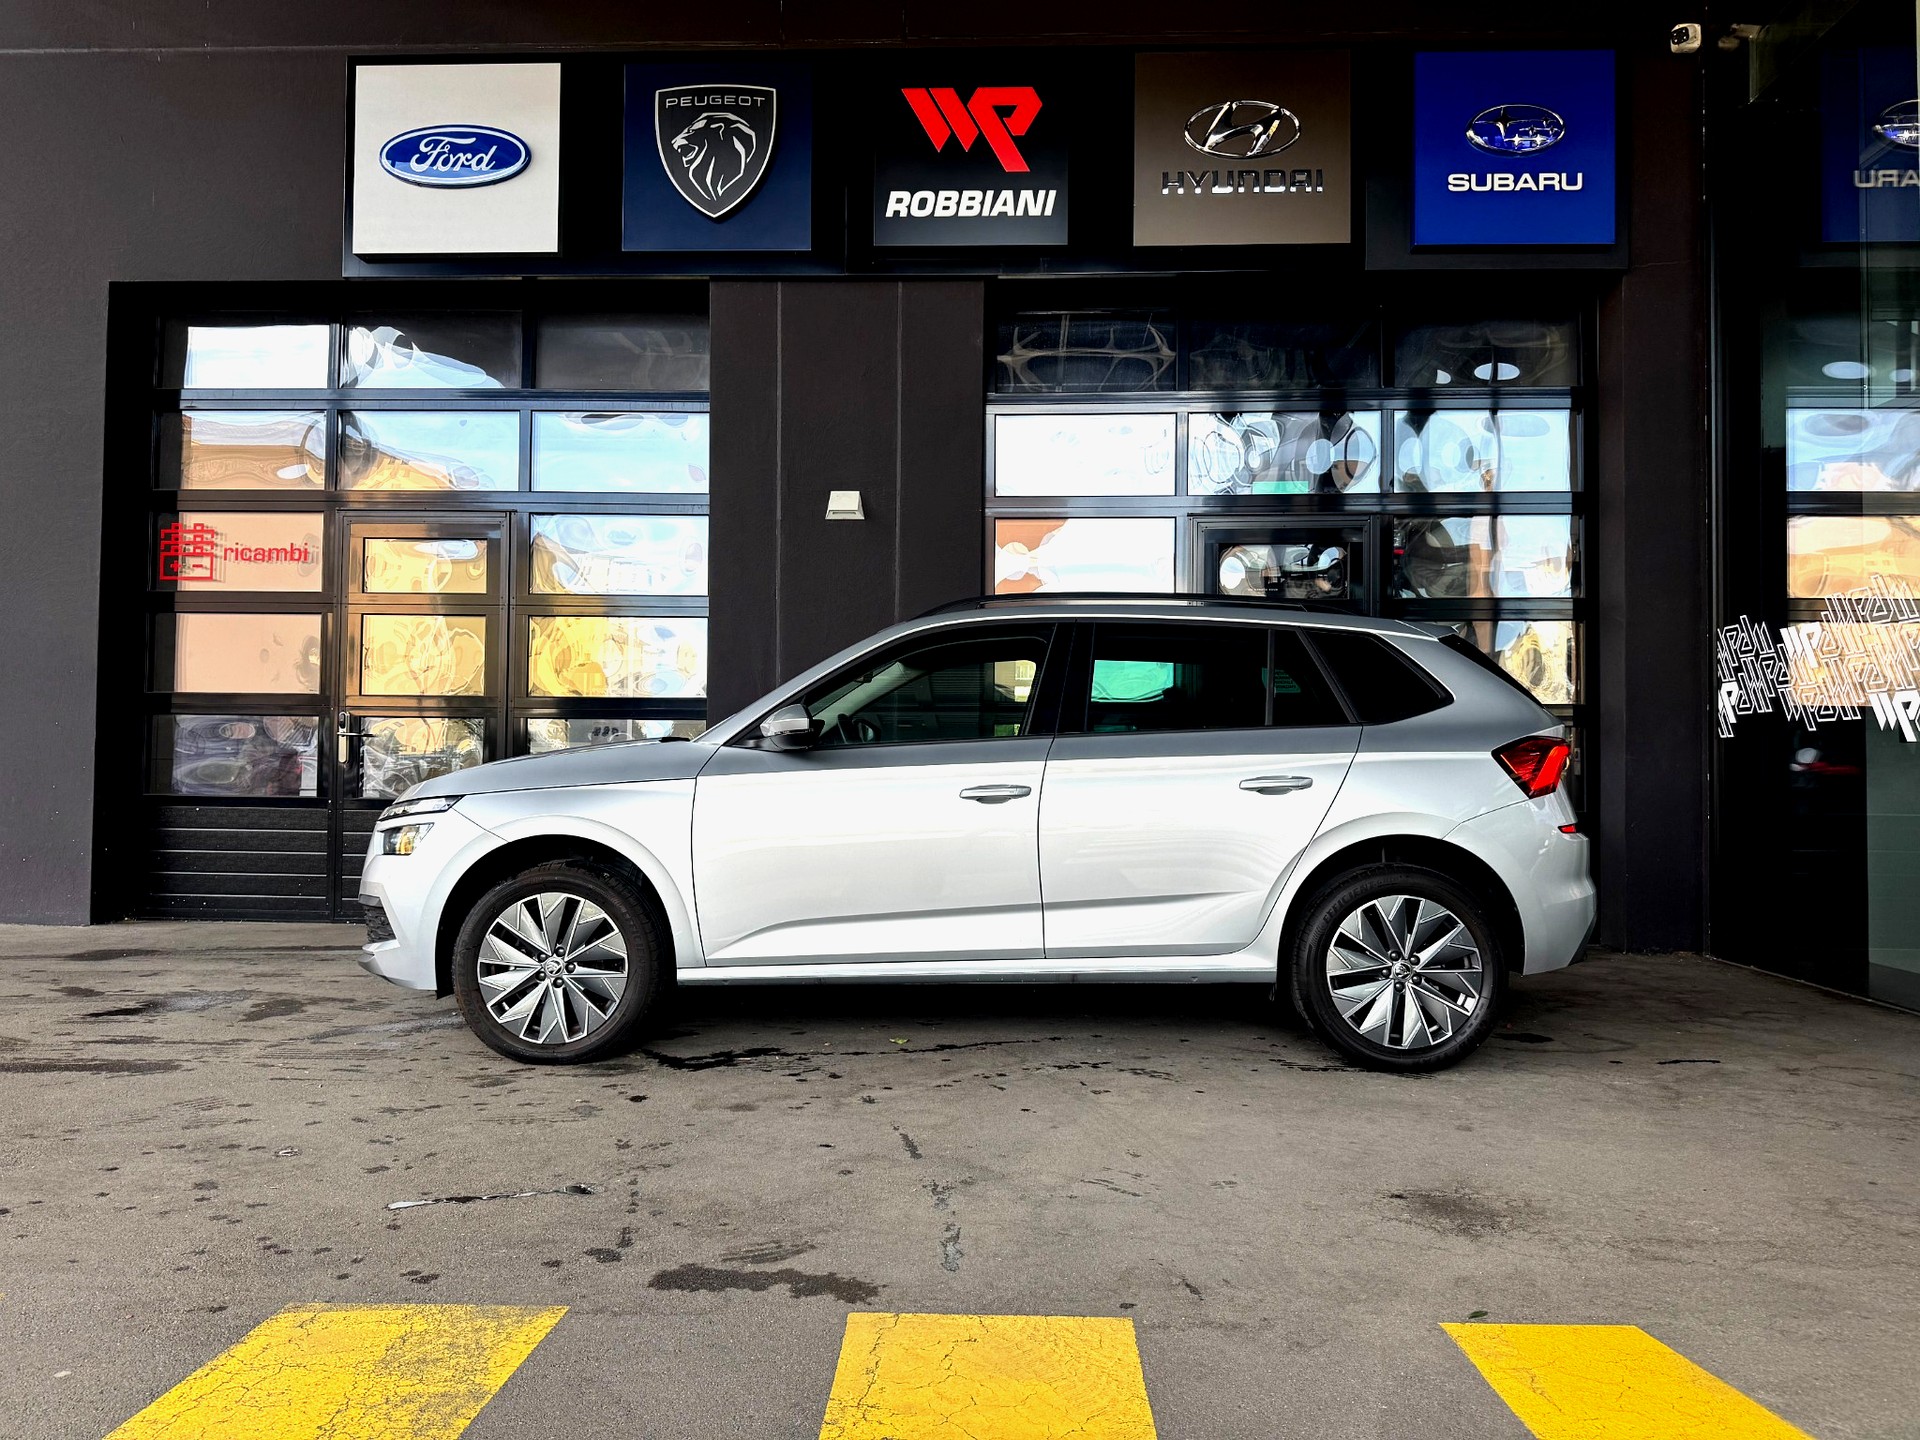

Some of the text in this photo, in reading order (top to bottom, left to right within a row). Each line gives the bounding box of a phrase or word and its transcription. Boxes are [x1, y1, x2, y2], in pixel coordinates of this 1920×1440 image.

[665, 94, 766, 110] PEUGEOT
[409, 136, 498, 173] Ford
[1162, 169, 1324, 195] HYUNDAI
[1447, 172, 1584, 192] SUBARU
[885, 189, 1057, 218] ROBBIANI
[223, 542, 309, 562] ricambi
